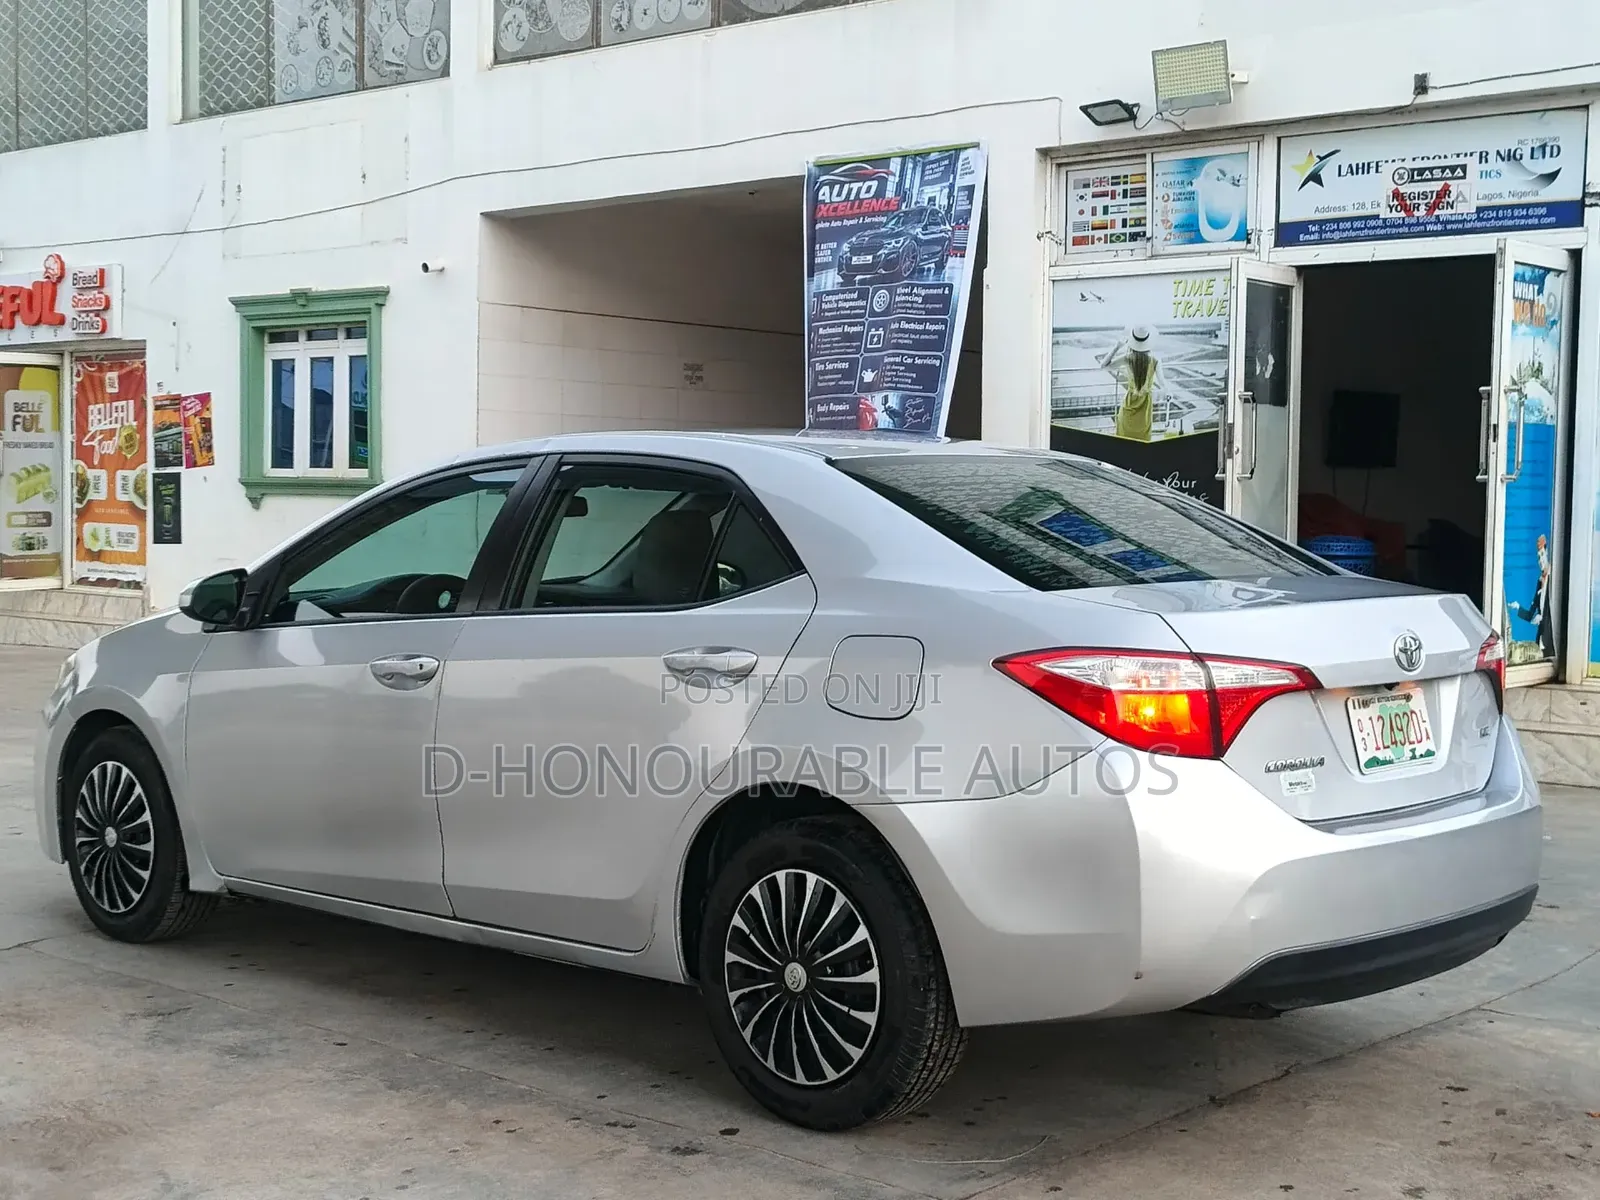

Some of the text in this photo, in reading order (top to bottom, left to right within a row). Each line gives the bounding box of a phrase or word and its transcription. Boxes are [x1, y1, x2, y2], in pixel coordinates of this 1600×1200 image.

[1495, 147, 1523, 163] NIG
[1530, 143, 1562, 160] LTD
[1413, 166, 1465, 180] LASAA
[1479, 169, 1502, 180] TICS
[1162, 180, 1185, 188] QATAR
[818, 180, 878, 203] AUTO
[1391, 190, 1452, 203] REGISTER
[1476, 192, 1506, 202] Lagos,
[1314, 200, 1382, 214] Address: 128, Ek
[1388, 201, 1455, 214] YOUR SIGN
[864, 216, 887, 224] Servicing
[1308, 224, 1320, 232] Tel:
[1322, 222, 1337, 230] +234
[1440, 212, 1478, 222] WhatsApp
[1300, 233, 1320, 241] Email:
[1426, 222, 1445, 232] Web:
[72, 268, 100, 287] Bread
[912, 286, 944, 296] Alignment
[944, 286, 950, 294] &
[1173, 276, 1231, 298] TIME T
[1514, 280, 1540, 300] WHAT
[71, 293, 104, 309] Snacks
[822, 290, 858, 302] Computerized
[0, 280, 65, 330] FUL
[822, 298, 867, 310] Vehicle Diagnostics
[1173, 298, 1230, 319] TRAVE
[72, 316, 101, 331] Drinks
[818, 324, 864, 335] Mechanical Repairs
[900, 320, 925, 330] Electrical
[926, 322, 946, 332] Repairs
[826, 360, 850, 370] Services
[884, 355, 902, 363] General
[914, 356, 940, 366] Servicing
[13, 401, 44, 412] BELLE
[817, 402, 850, 413] Body Repairs
[12, 414, 46, 433] FUL
[1264, 756, 1325, 774] COROLLA
